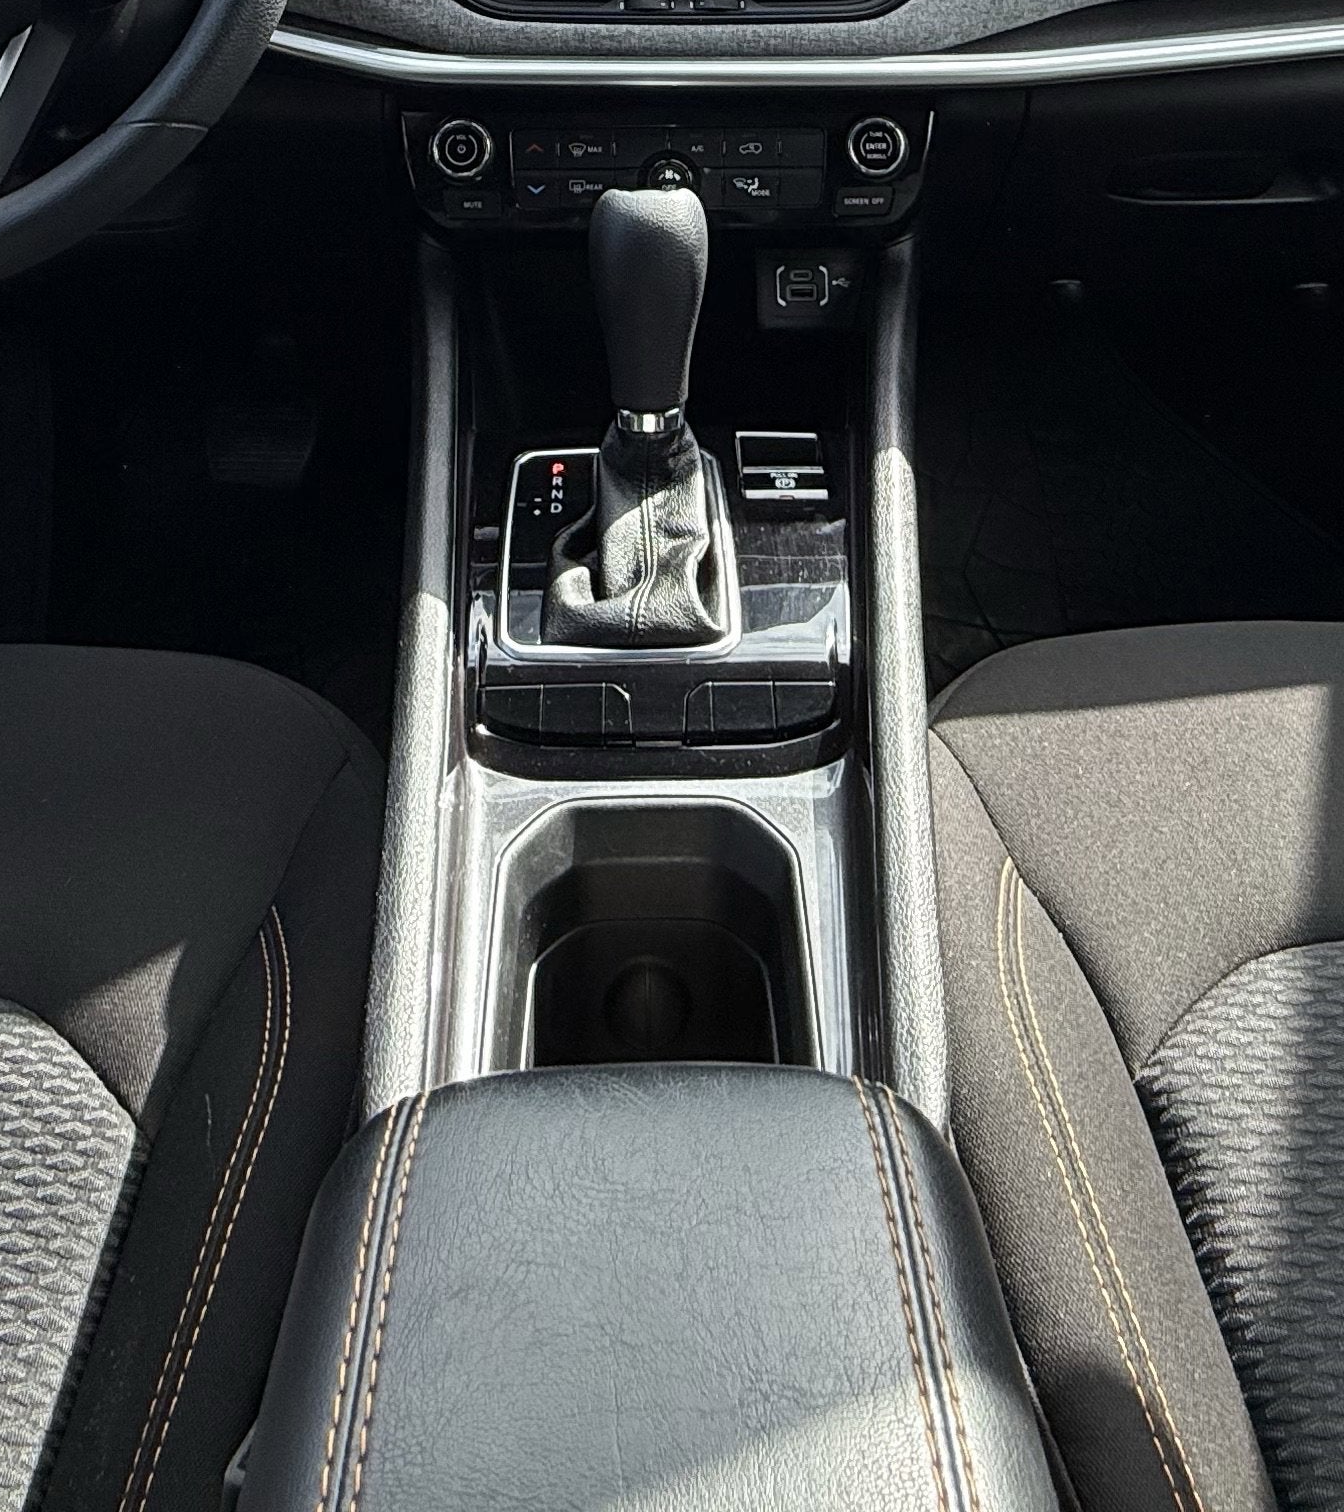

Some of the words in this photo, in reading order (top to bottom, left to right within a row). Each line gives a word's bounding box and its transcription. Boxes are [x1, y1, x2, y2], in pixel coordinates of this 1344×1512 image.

[463, 201, 483, 209] MUTE
[843, 197, 869, 205] SCREEN
[552, 463, 565, 475] P
[552, 476, 563, 487] R
[551, 489, 563, 500] N
[550, 502, 563, 514] D
